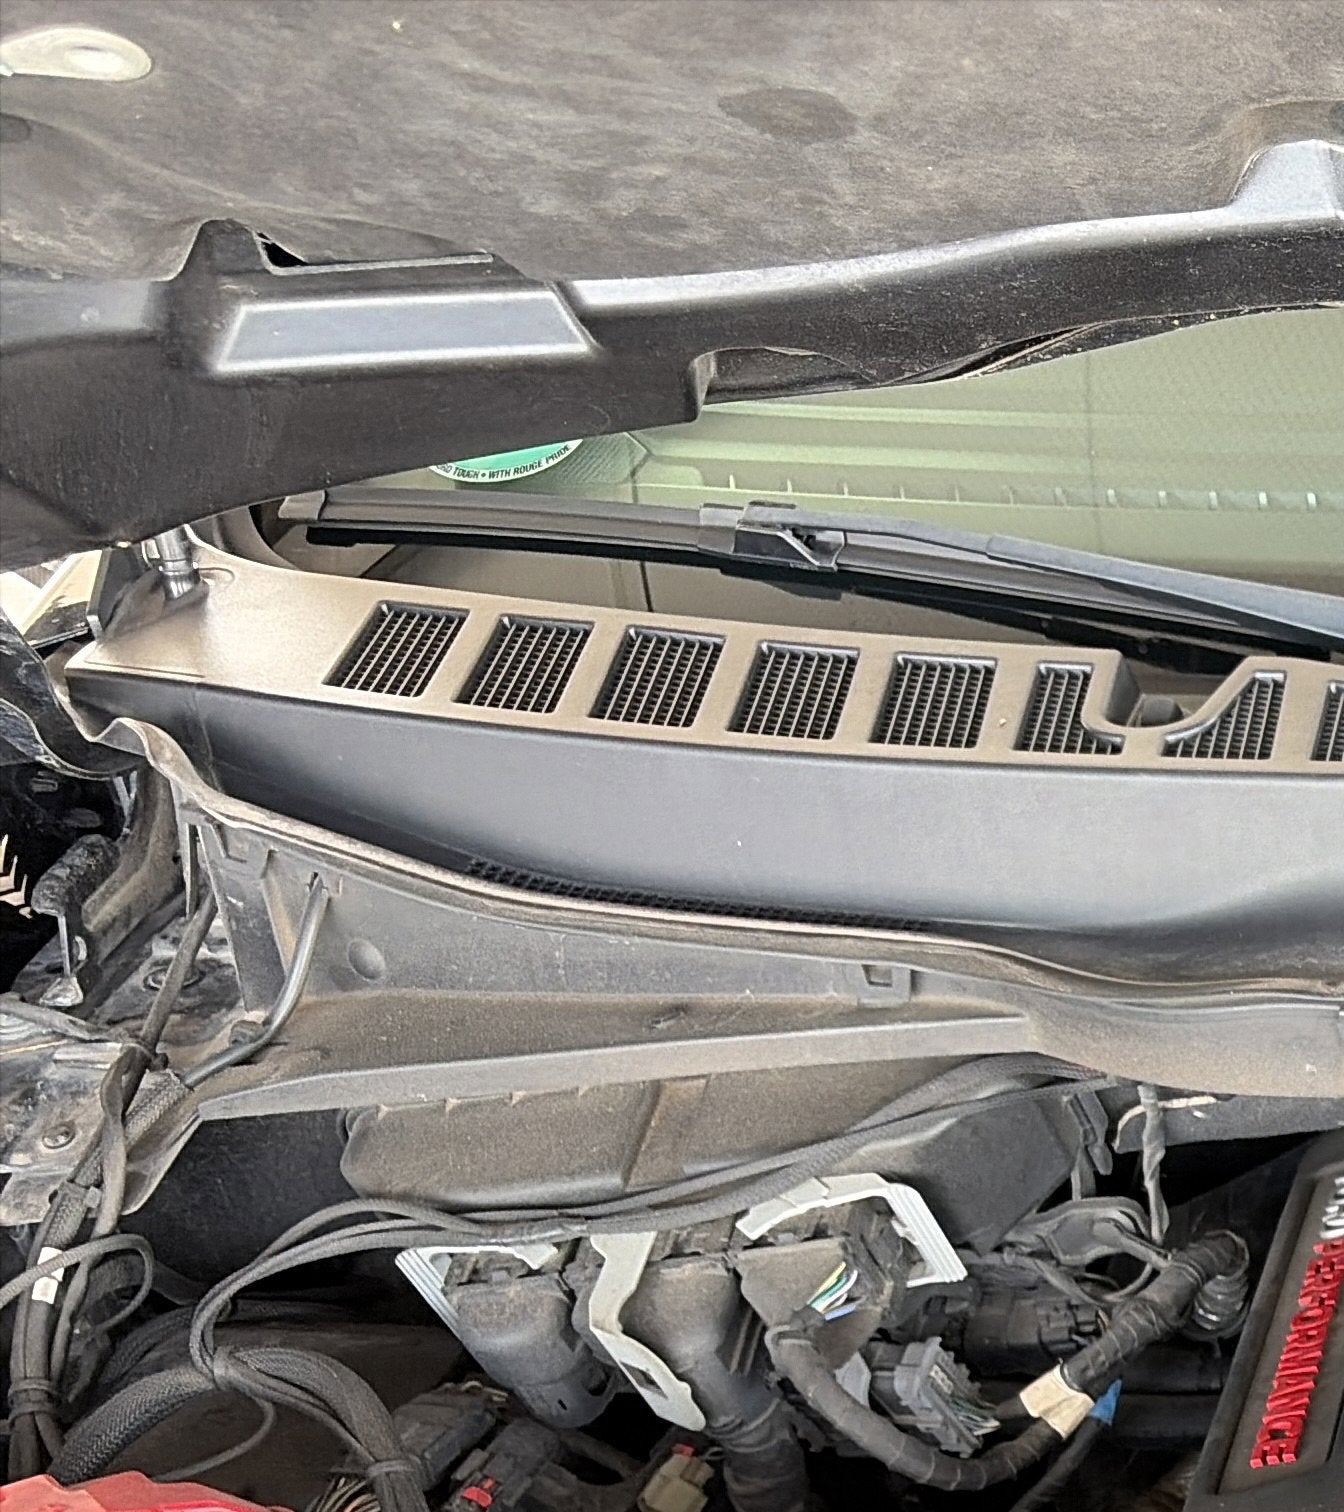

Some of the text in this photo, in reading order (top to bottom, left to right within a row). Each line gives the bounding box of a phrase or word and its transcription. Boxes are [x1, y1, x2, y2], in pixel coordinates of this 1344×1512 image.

[453, 466, 479, 479] TOUGH
[488, 470, 511, 479] WITH
[513, 460, 543, 476] ROUGE
